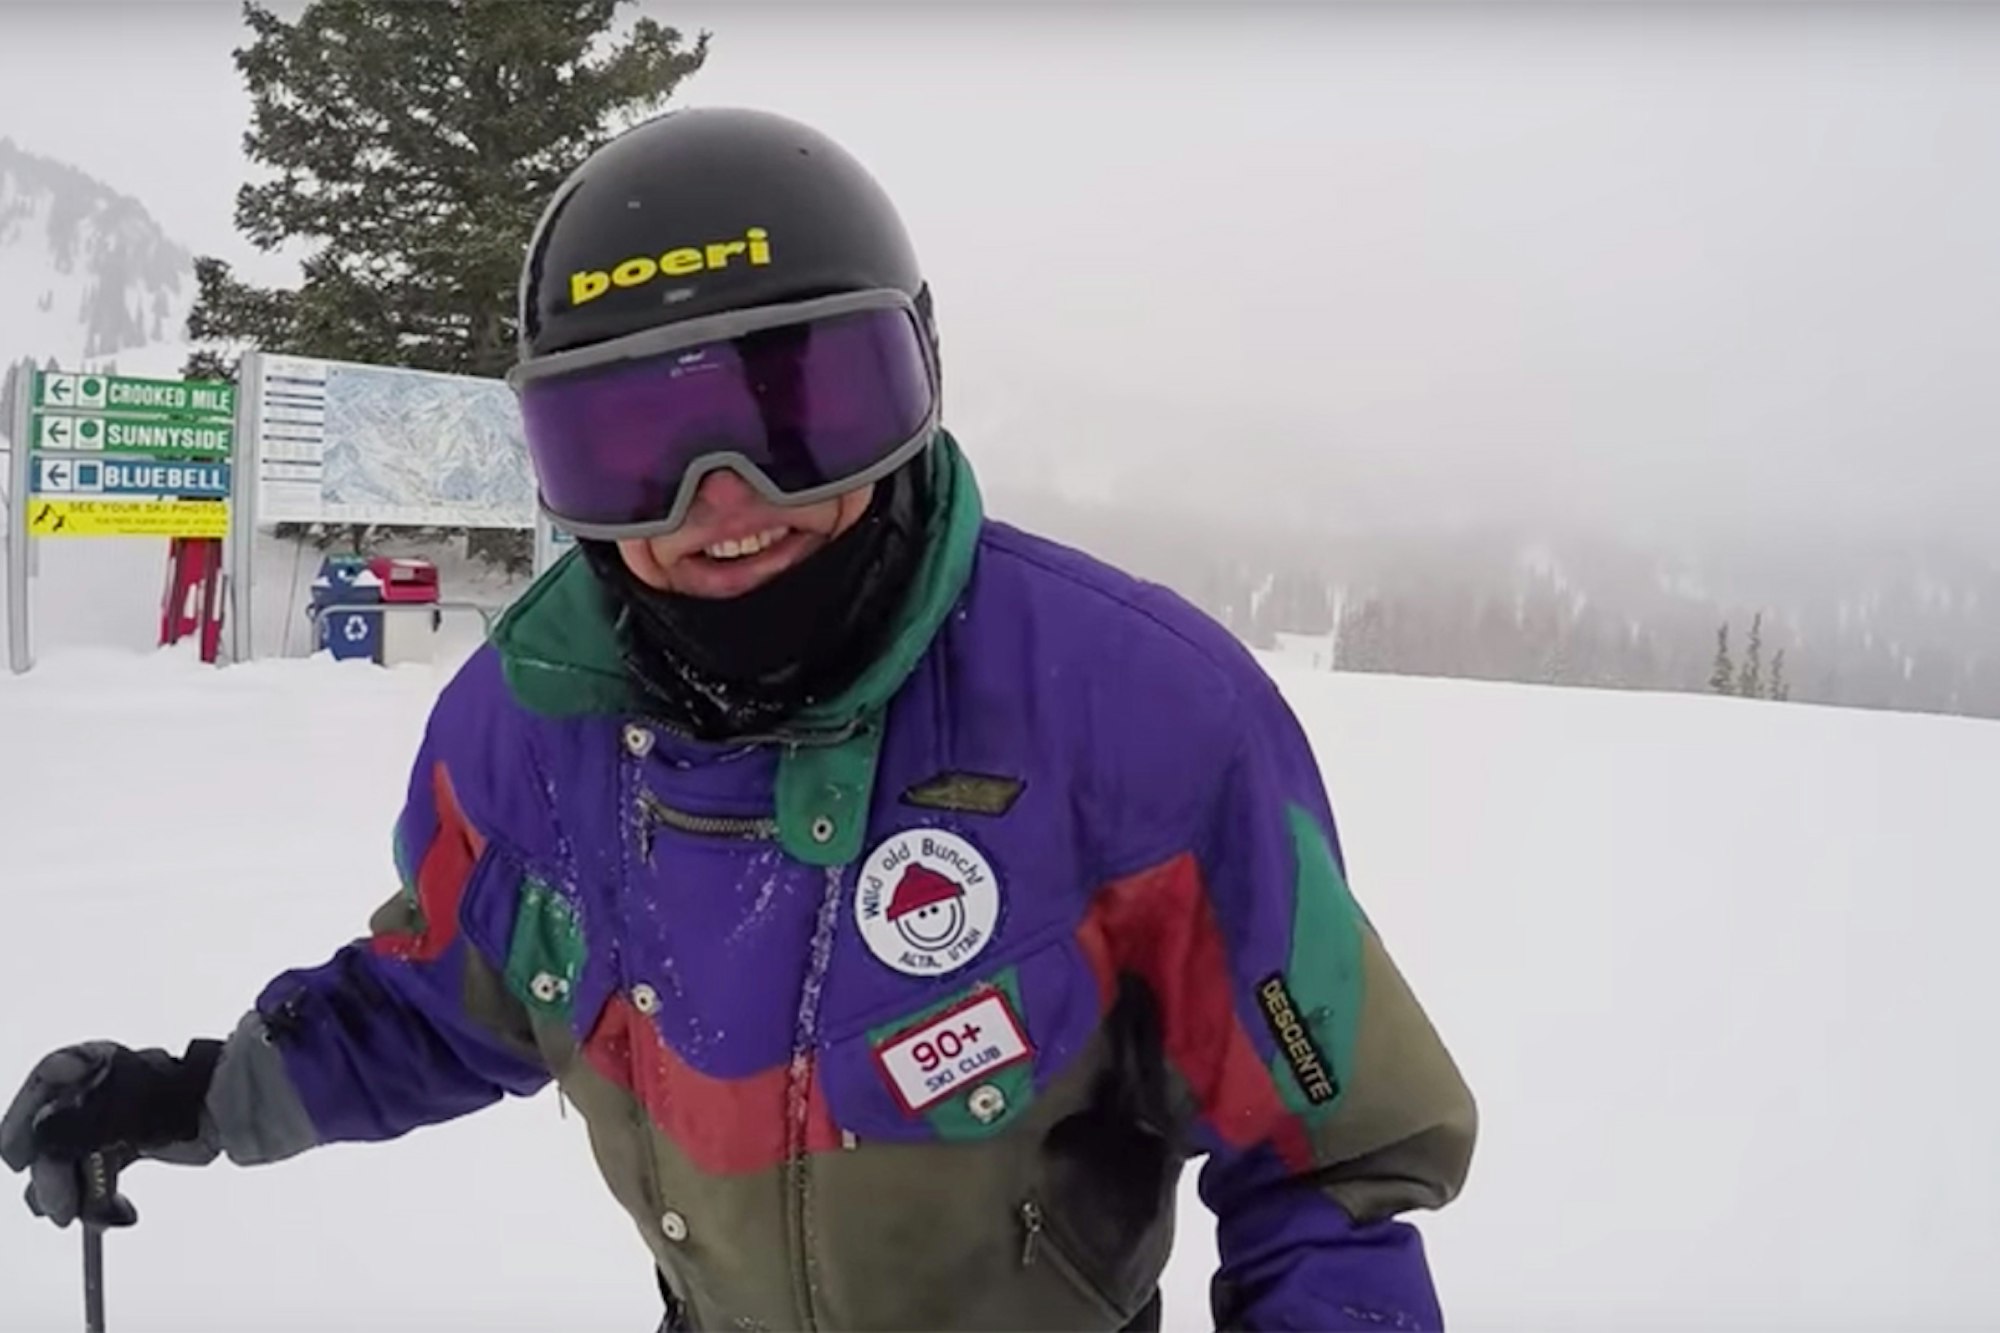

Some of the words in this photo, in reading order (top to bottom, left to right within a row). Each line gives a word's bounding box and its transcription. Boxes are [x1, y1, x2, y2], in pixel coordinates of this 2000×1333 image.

[570, 227, 770, 305] boeri
[108, 382, 186, 407] CROOKED
[192, 388, 231, 414] MILE
[107, 423, 229, 450] SUNNYSIDE
[104, 465, 226, 490] BLUEBELL
[68, 502, 96, 513] SEE
[102, 502, 141, 514] YOUR
[863, 875, 883, 920] Wild
[921, 837, 985, 886] Bunch!
[947, 928, 982, 961] UTAH
[911, 1022, 981, 1072] 90+
[925, 1069, 956, 1093] SKI
[958, 1045, 1001, 1074] CLUB
